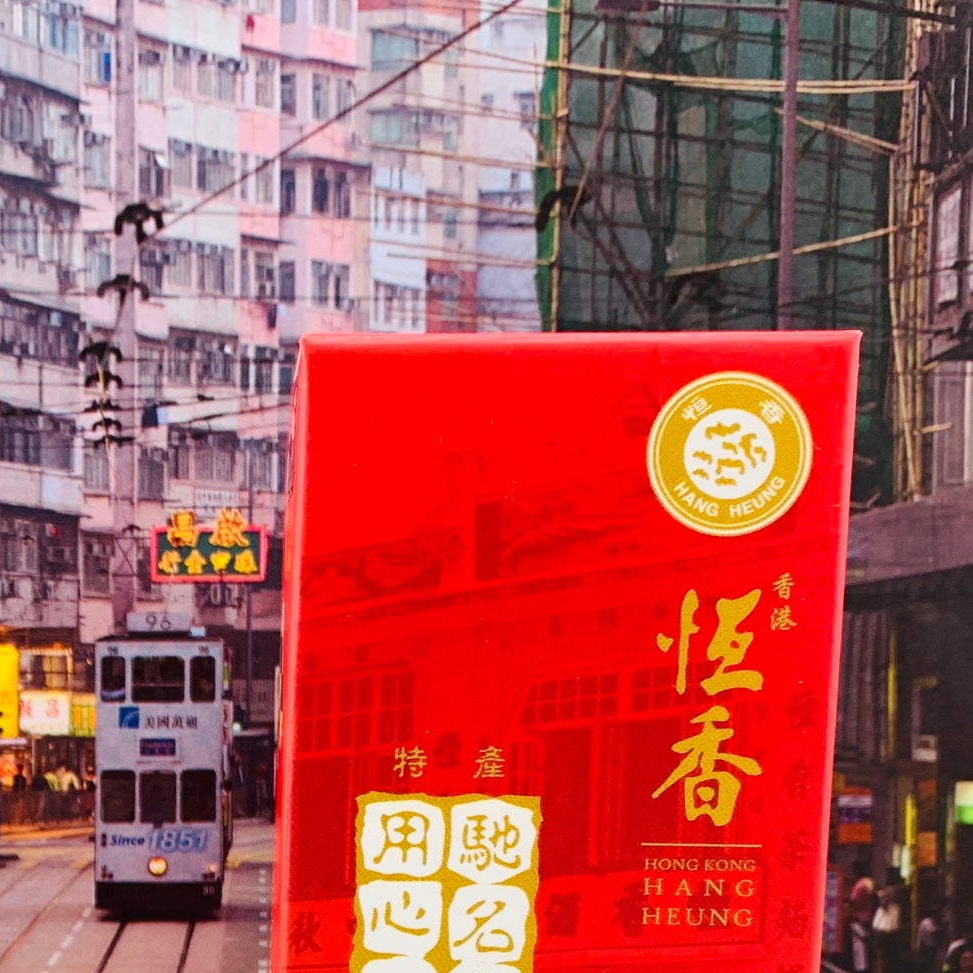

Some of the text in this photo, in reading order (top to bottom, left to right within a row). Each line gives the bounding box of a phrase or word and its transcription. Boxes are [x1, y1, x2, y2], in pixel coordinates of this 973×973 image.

[673, 475, 786, 518] HANG HEUNG
[770, 572, 798, 631] 香港
[145, 614, 172, 631] 96
[652, 588, 764, 827] 恒香
[393, 745, 505, 779] 特產
[110, 828, 209, 854] Since 1851
[644, 857, 757, 873] HONG KONG
[643, 877, 756, 898] HANG
[641, 907, 754, 928] HEUNG
